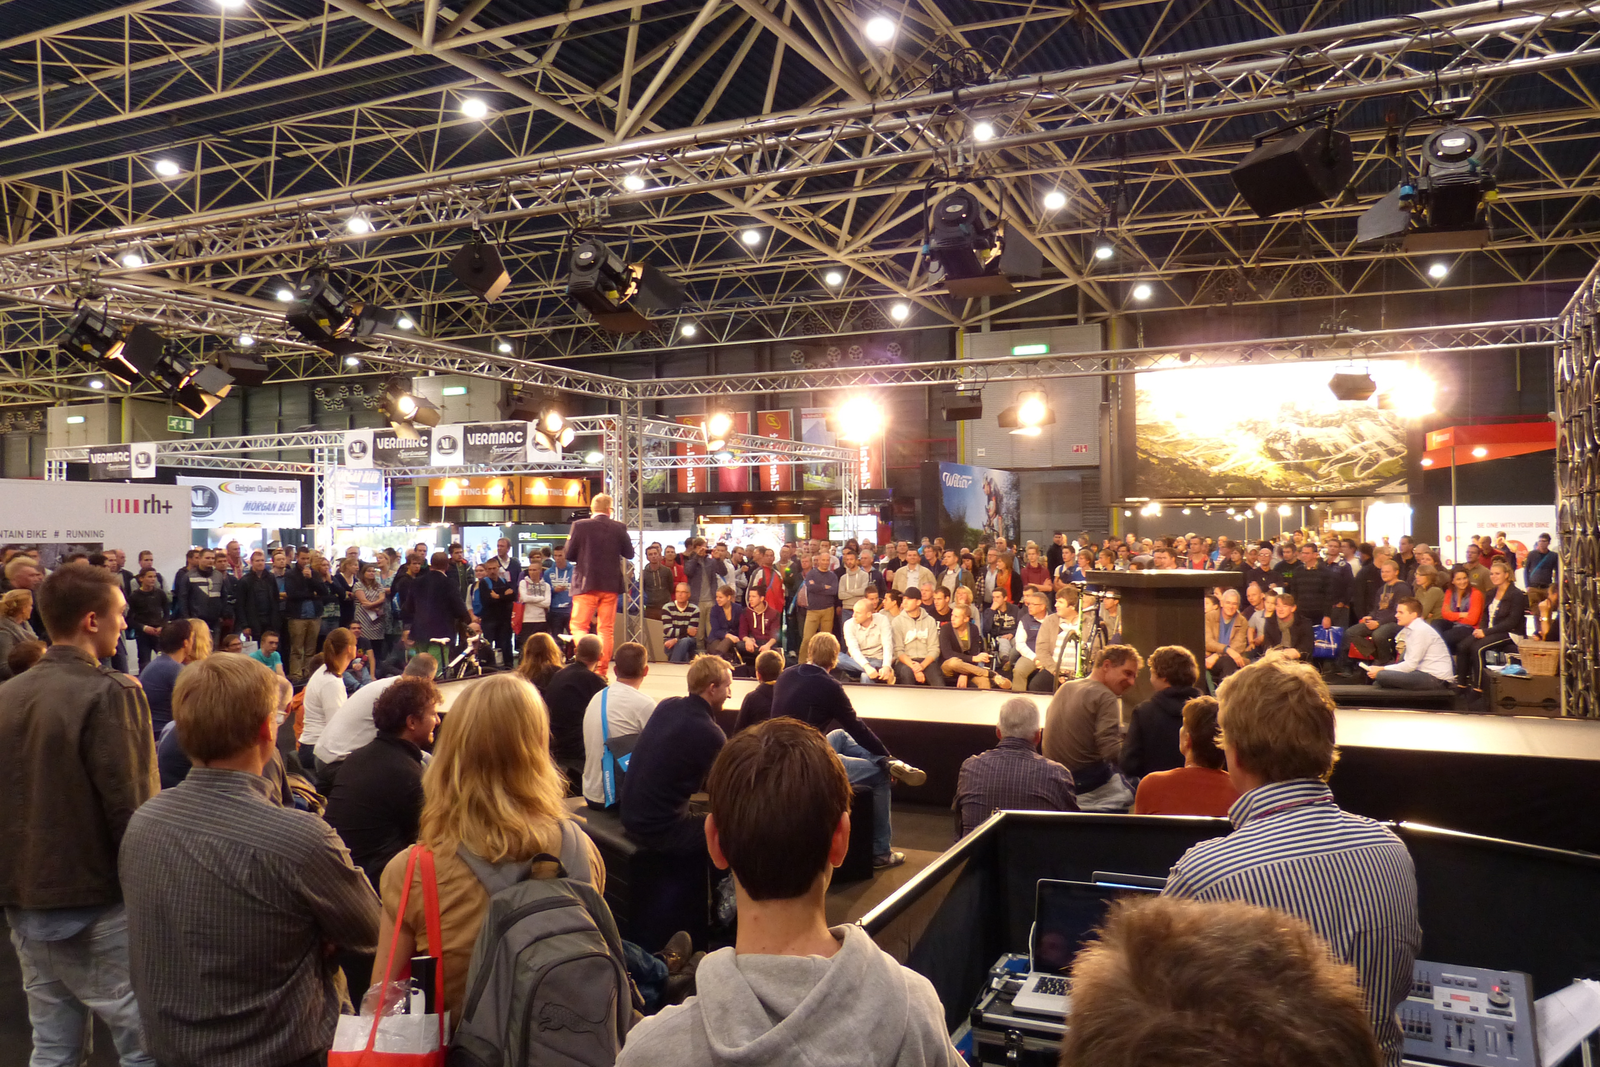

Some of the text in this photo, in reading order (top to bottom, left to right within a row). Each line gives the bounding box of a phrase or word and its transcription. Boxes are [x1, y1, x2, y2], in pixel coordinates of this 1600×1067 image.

[376, 436, 428, 450] VERMARC
[467, 431, 523, 446] VERMARC
[90, 451, 130, 464] VERMARC
[235, 484, 298, 495] Belgian Quality Brands
[143, 493, 173, 514] rh+
[242, 501, 297, 512] MORGAN BLUE
[26, 530, 47, 538] BIKE
[54, 530, 60, 538] #
[66, 530, 105, 538] RUNNING
